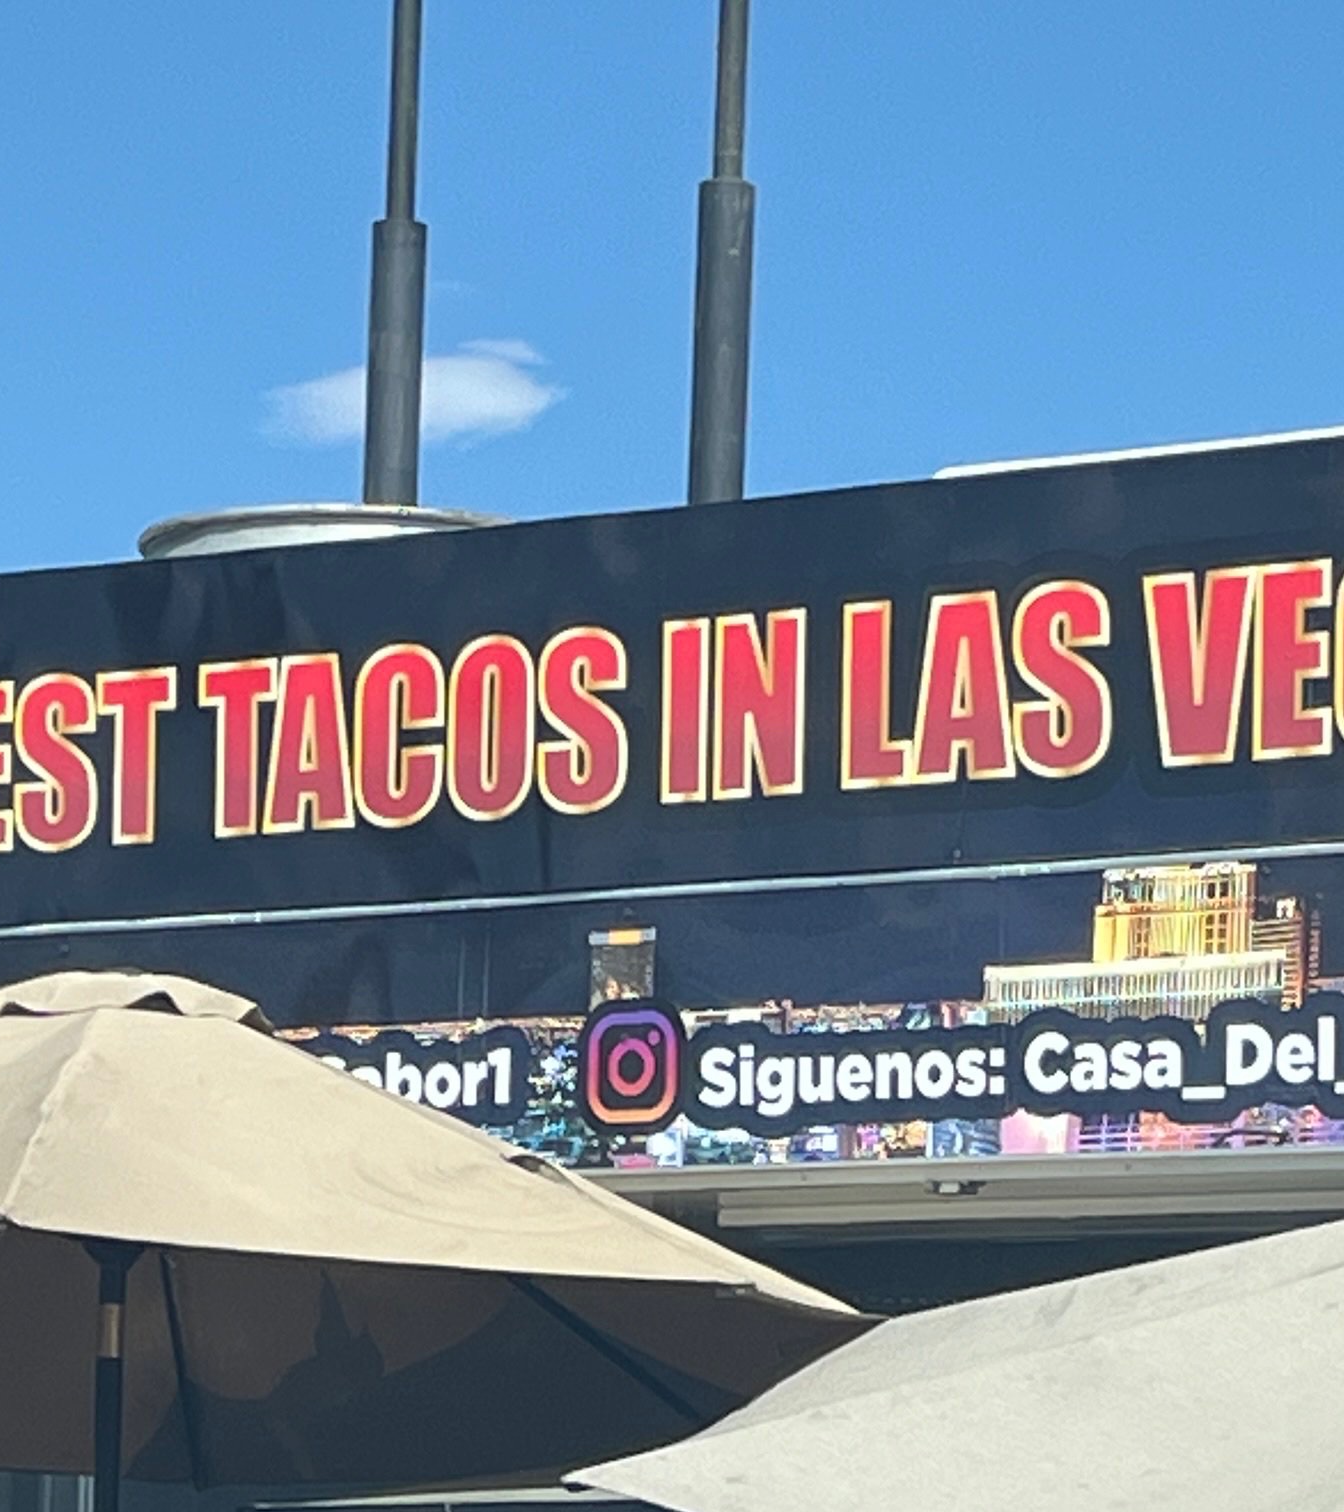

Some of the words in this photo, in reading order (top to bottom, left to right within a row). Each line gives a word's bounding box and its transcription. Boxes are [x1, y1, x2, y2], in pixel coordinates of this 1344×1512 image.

[199, 627, 628, 838] TACOS
[660, 608, 807, 804] IN
[840, 581, 1112, 790] LAS
[697, 1044, 1006, 1112] Siguenos:
